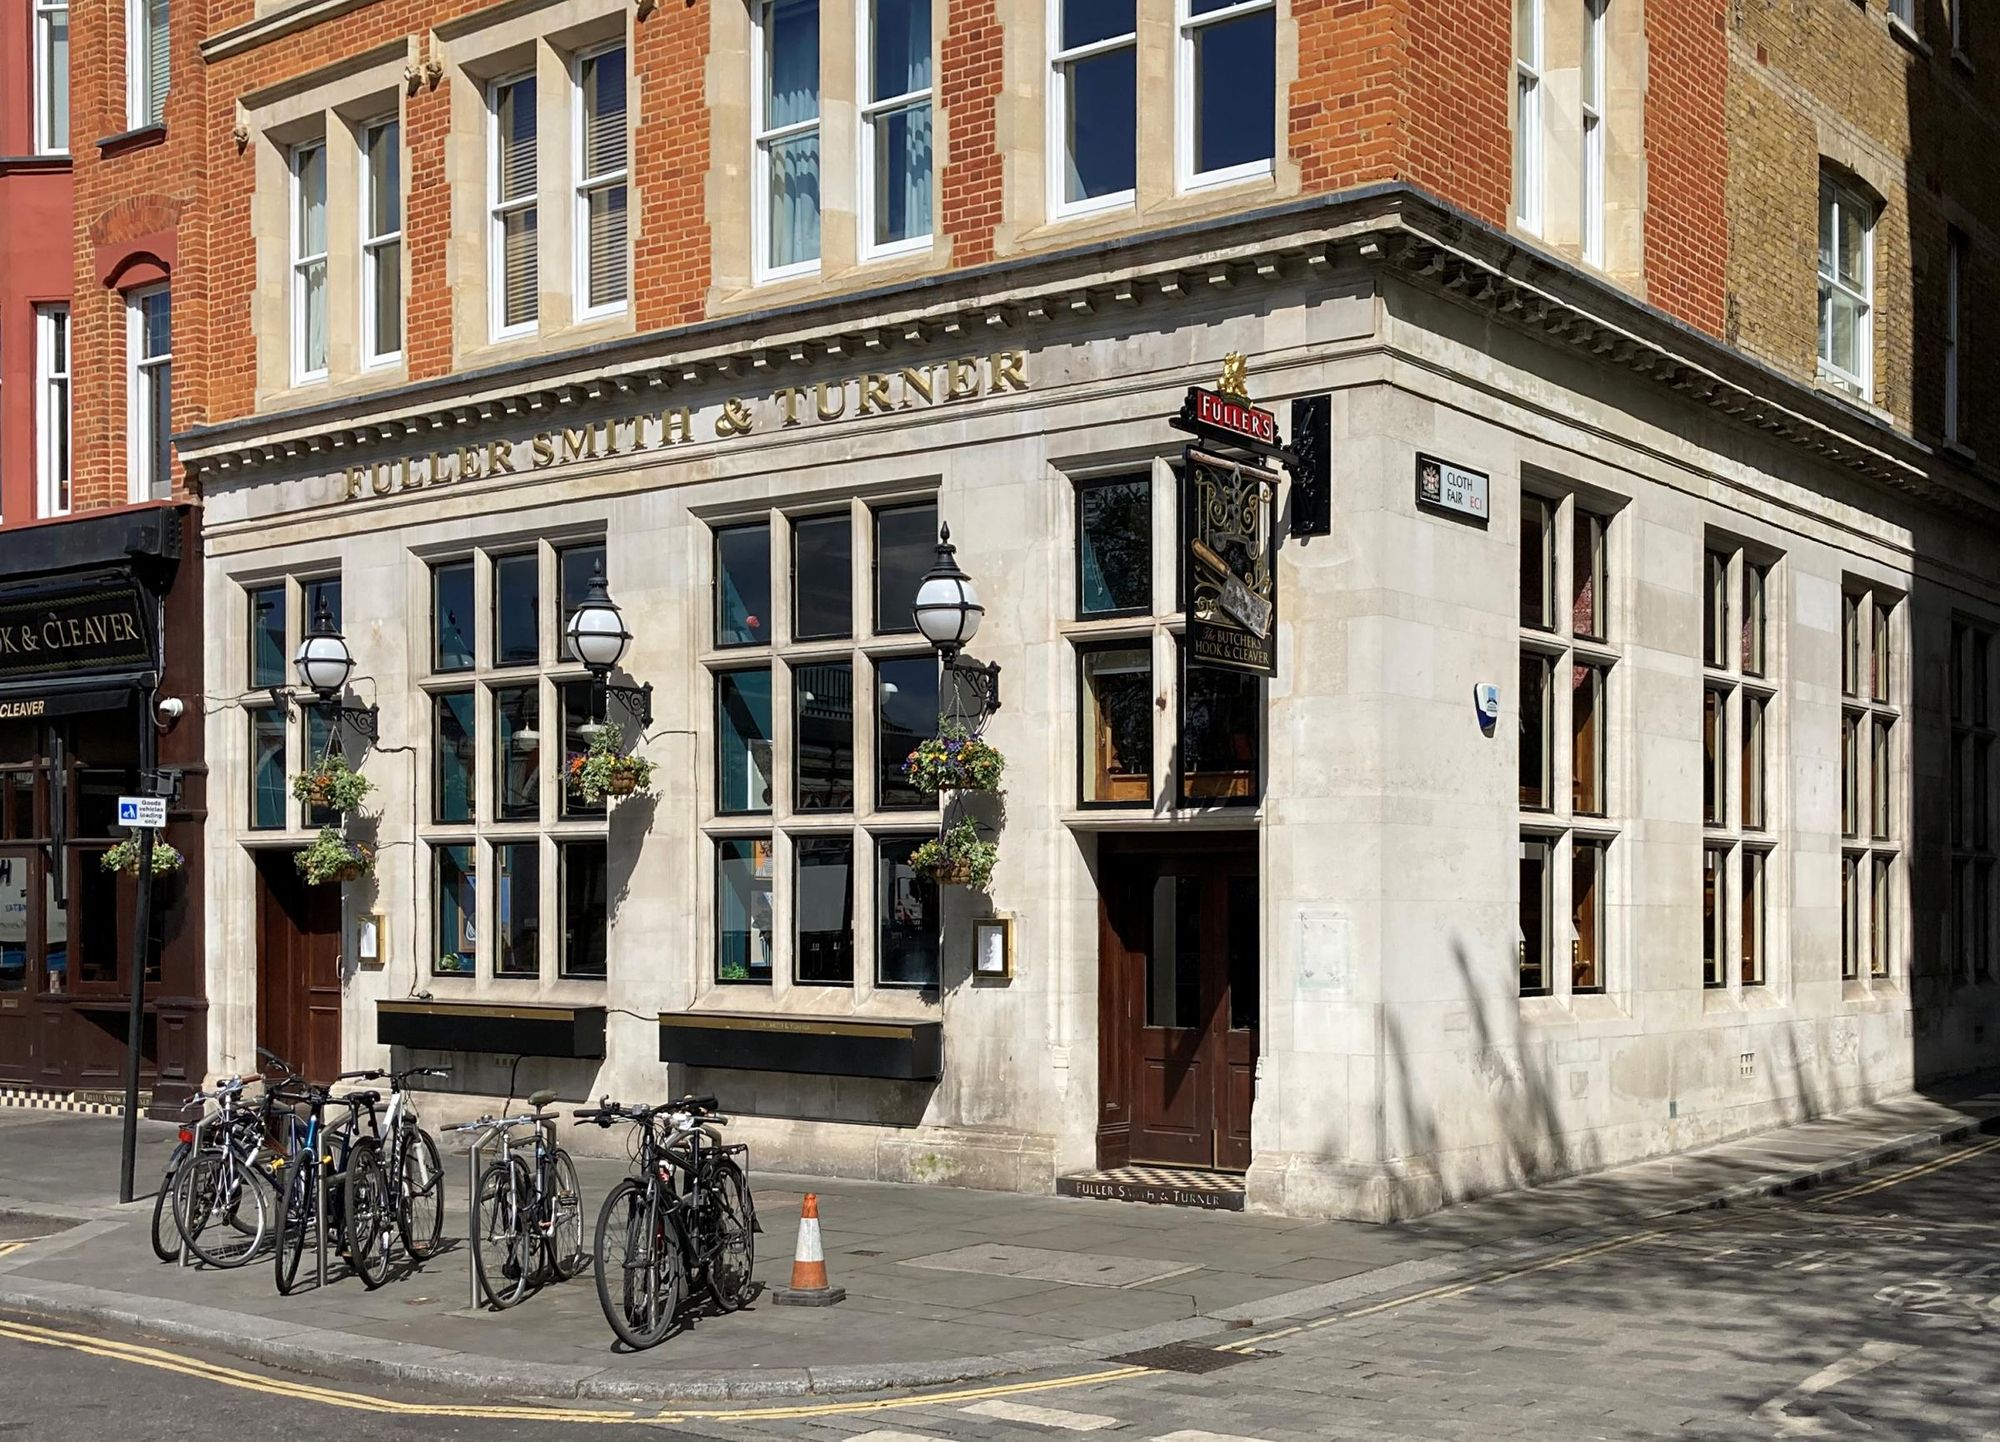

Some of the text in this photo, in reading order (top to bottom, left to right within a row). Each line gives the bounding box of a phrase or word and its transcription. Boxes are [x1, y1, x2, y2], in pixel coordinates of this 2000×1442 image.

[342, 439, 515, 499] FULLER
[531, 406, 696, 470] SMITH
[714, 396, 753, 437] &
[774, 349, 1030, 428] TURNER
[1203, 395, 1270, 437] FULLER'S
[1447, 472, 1473, 491] CLOTH
[1447, 489, 1463, 505] FAIR
[0, 612, 140, 653] K & CLEAVER
[1202, 627, 1262, 649] The BUTCHERS
[1195, 640, 1269, 665] HOOK & CLEAVER
[0, 700, 44, 717] CLEAVER
[1076, 1182, 1114, 1196] FULLER
